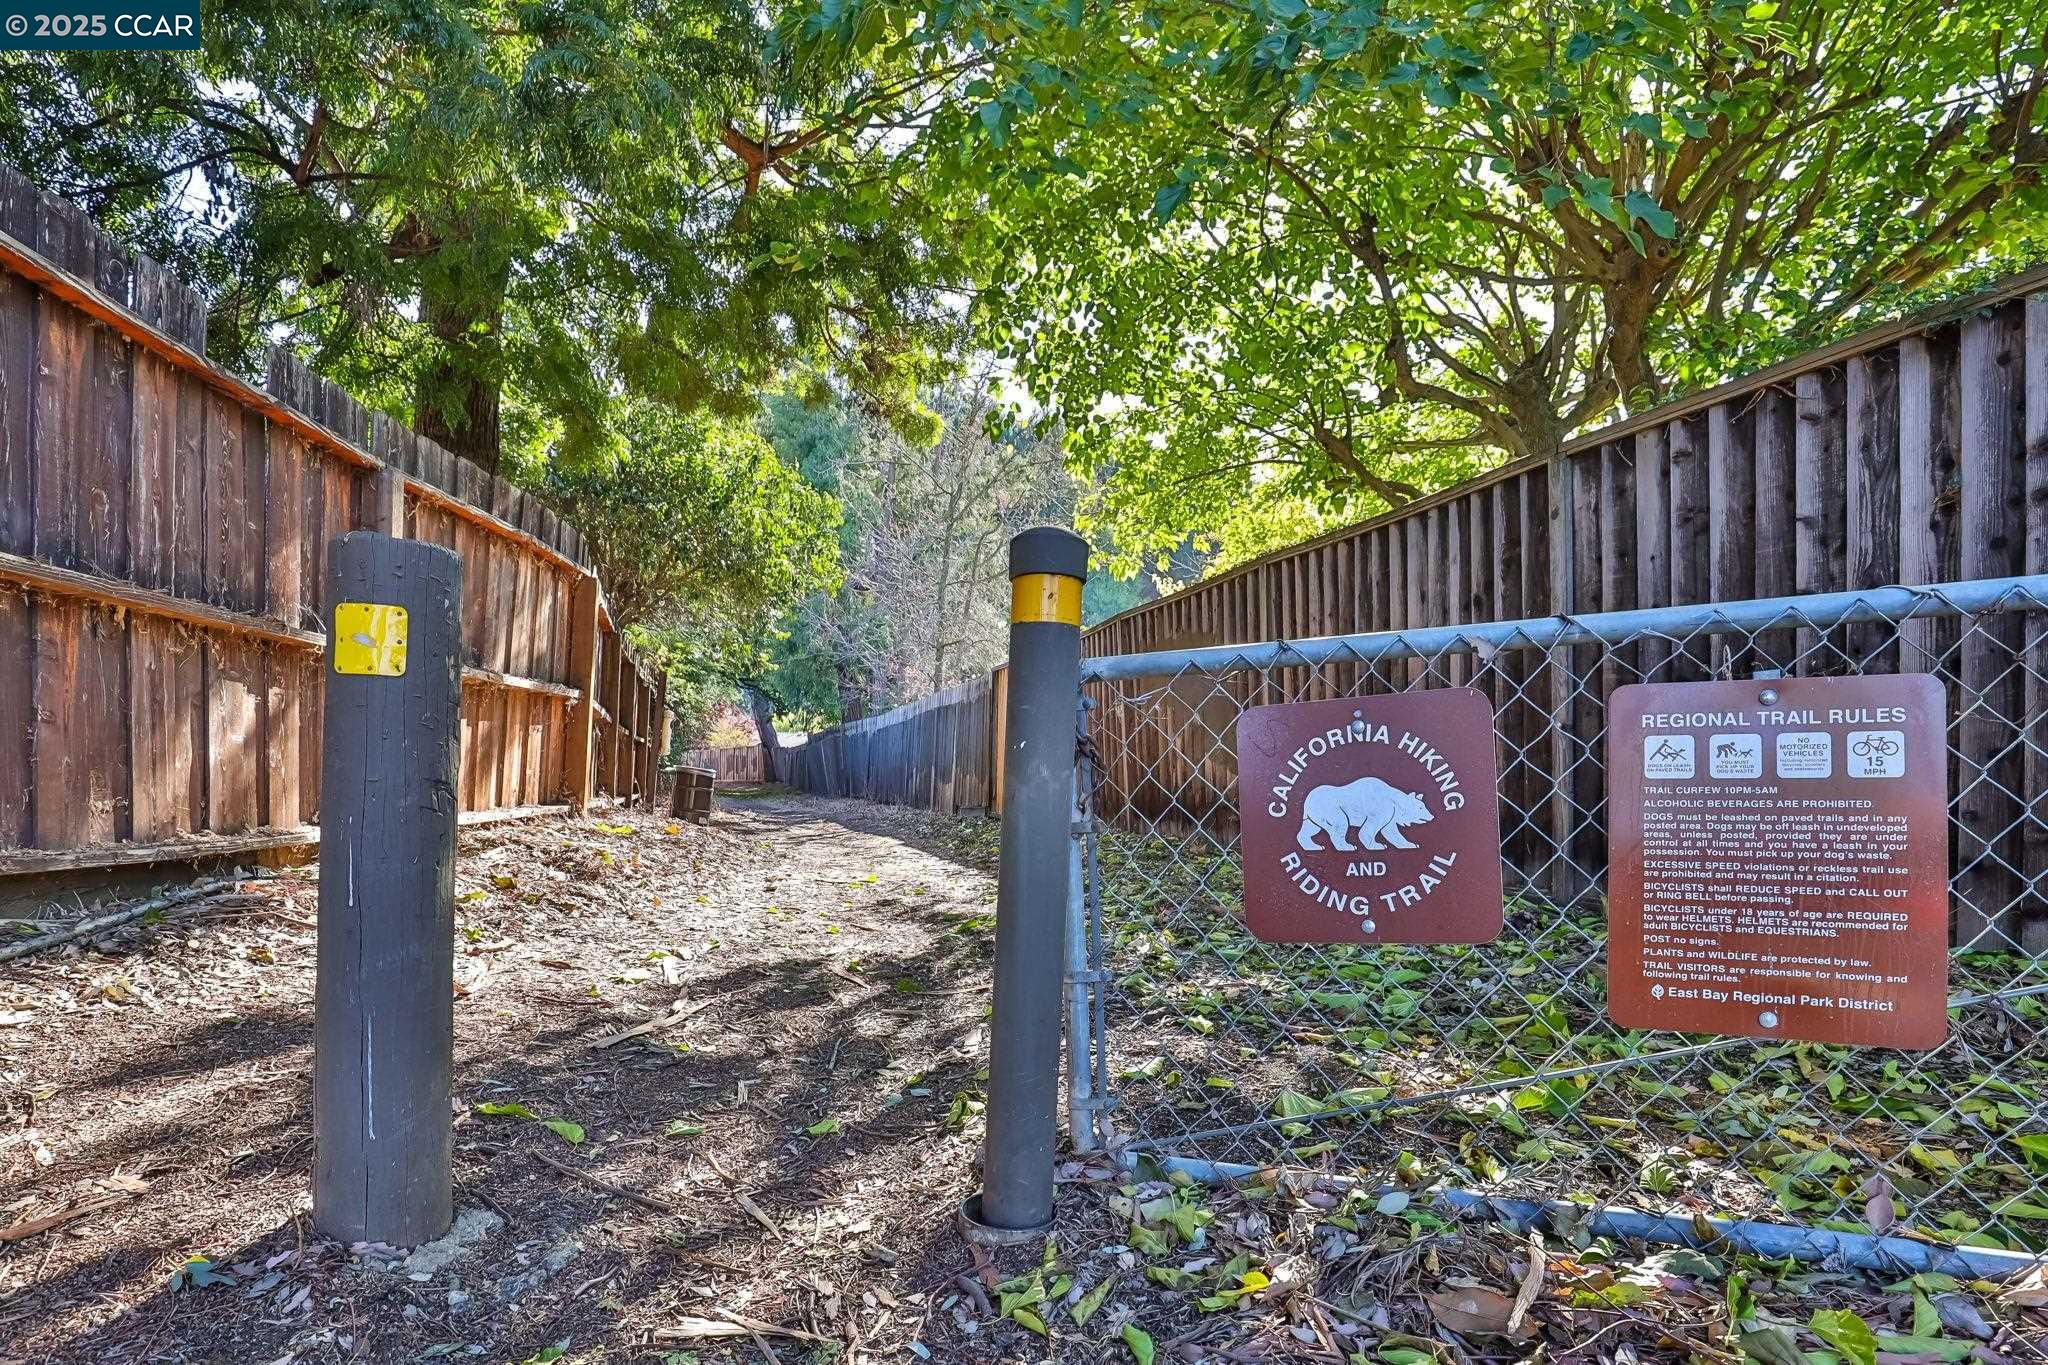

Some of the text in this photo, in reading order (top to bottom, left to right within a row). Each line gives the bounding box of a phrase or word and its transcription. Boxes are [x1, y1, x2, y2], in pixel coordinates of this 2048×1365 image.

[1642, 708, 1906, 728] REGIONAL TRAIL RULES
[1867, 756, 1884, 766] 15
[1268, 724, 1464, 818] CALIFORNIA HIKING
[1782, 814, 1813, 823] paved
[1644, 822, 1677, 831] posted
[1707, 822, 1733, 832] Dogs
[1837, 824, 1908, 833] undeveloped
[1720, 832, 1758, 840] posted,
[1766, 832, 1812, 841] provided
[1819, 833, 1842, 842] they
[1644, 848, 1702, 857] possession.
[1756, 850, 1777, 859] pick
[1824, 851, 1854, 860] dog's
[1346, 862, 1386, 876] AND
[1644, 861, 1701, 869] EXCESSIVE
[1744, 863, 1795, 872] violations
[1662, 870, 1712, 879] prohibited
[1816, 874, 1859, 882] citation.
[1280, 851, 1456, 916] RIDING TRAIL
[1644, 882, 1705, 892] BICYCLISTS
[1736, 885, 1780, 894] REDUCE
[1785, 887, 1822, 895] SPEED
[1849, 889, 1880, 897] CALL
[1884, 890, 1908, 898] OUT
[1657, 891, 1682, 900] RING
[1685, 892, 1712, 901] BELL
[1715, 893, 1748, 902] before
[1750, 896, 1794, 905] passing.
[1644, 904, 1704, 914] BICYCLISTS
[1708, 907, 1738, 915] under
[1803, 912, 1823, 920] age
[1847, 912, 1908, 922] REQUIRED
[1682, 914, 1734, 924] HELMETS.
[1738, 917, 1789, 926] HELMETS
[1812, 921, 1889, 930] recommended
[1893, 923, 1908, 931] for
[1644, 922, 1668, 930] adult
[1671, 923, 1733, 933] BICYCLISTS
[1758, 927, 1839, 938] EQUESTRIANS.
[1644, 934, 1670, 943] POST
[1689, 937, 1719, 947] signs.
[1644, 948, 1684, 957] PLANTS
[1708, 951, 1758, 961] WILDLIFE
[1781, 956, 1831, 965] protected
[1834, 958, 1847, 968] by
[1851, 959, 1871, 967] law.
[1643, 961, 1672, 970] TRAIL
[1677, 963, 1726, 973] VISITORS
[1750, 969, 1811, 978] responsible
[1816, 971, 1831, 979] for
[1836, 972, 1882, 984] knowing
[1643, 970, 1741, 983] following trail rules.
[1669, 987, 1893, 1011] East Bay Regional Park District
